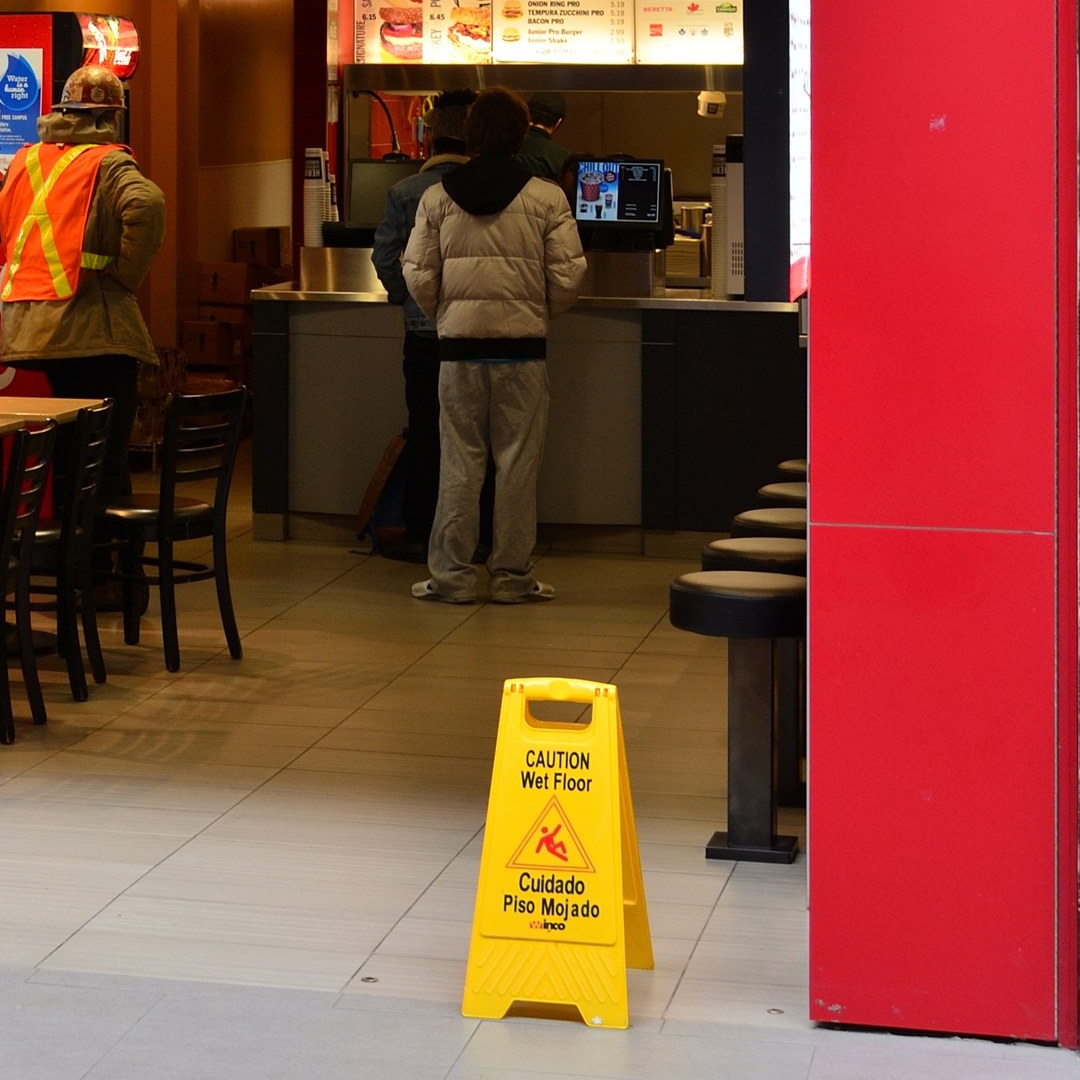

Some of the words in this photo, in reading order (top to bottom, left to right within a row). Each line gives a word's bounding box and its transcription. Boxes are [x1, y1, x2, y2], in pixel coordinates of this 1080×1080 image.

[356, 20, 365, 64] SIGNATURE
[11, 92, 28, 100] right
[525, 750, 590, 770] CAUTION
[521, 771, 549, 790] Wet
[553, 772, 592, 792] Floor
[518, 872, 585, 895] Cuidado
[503, 894, 535, 914] Piso
[541, 897, 600, 921] Mojado
